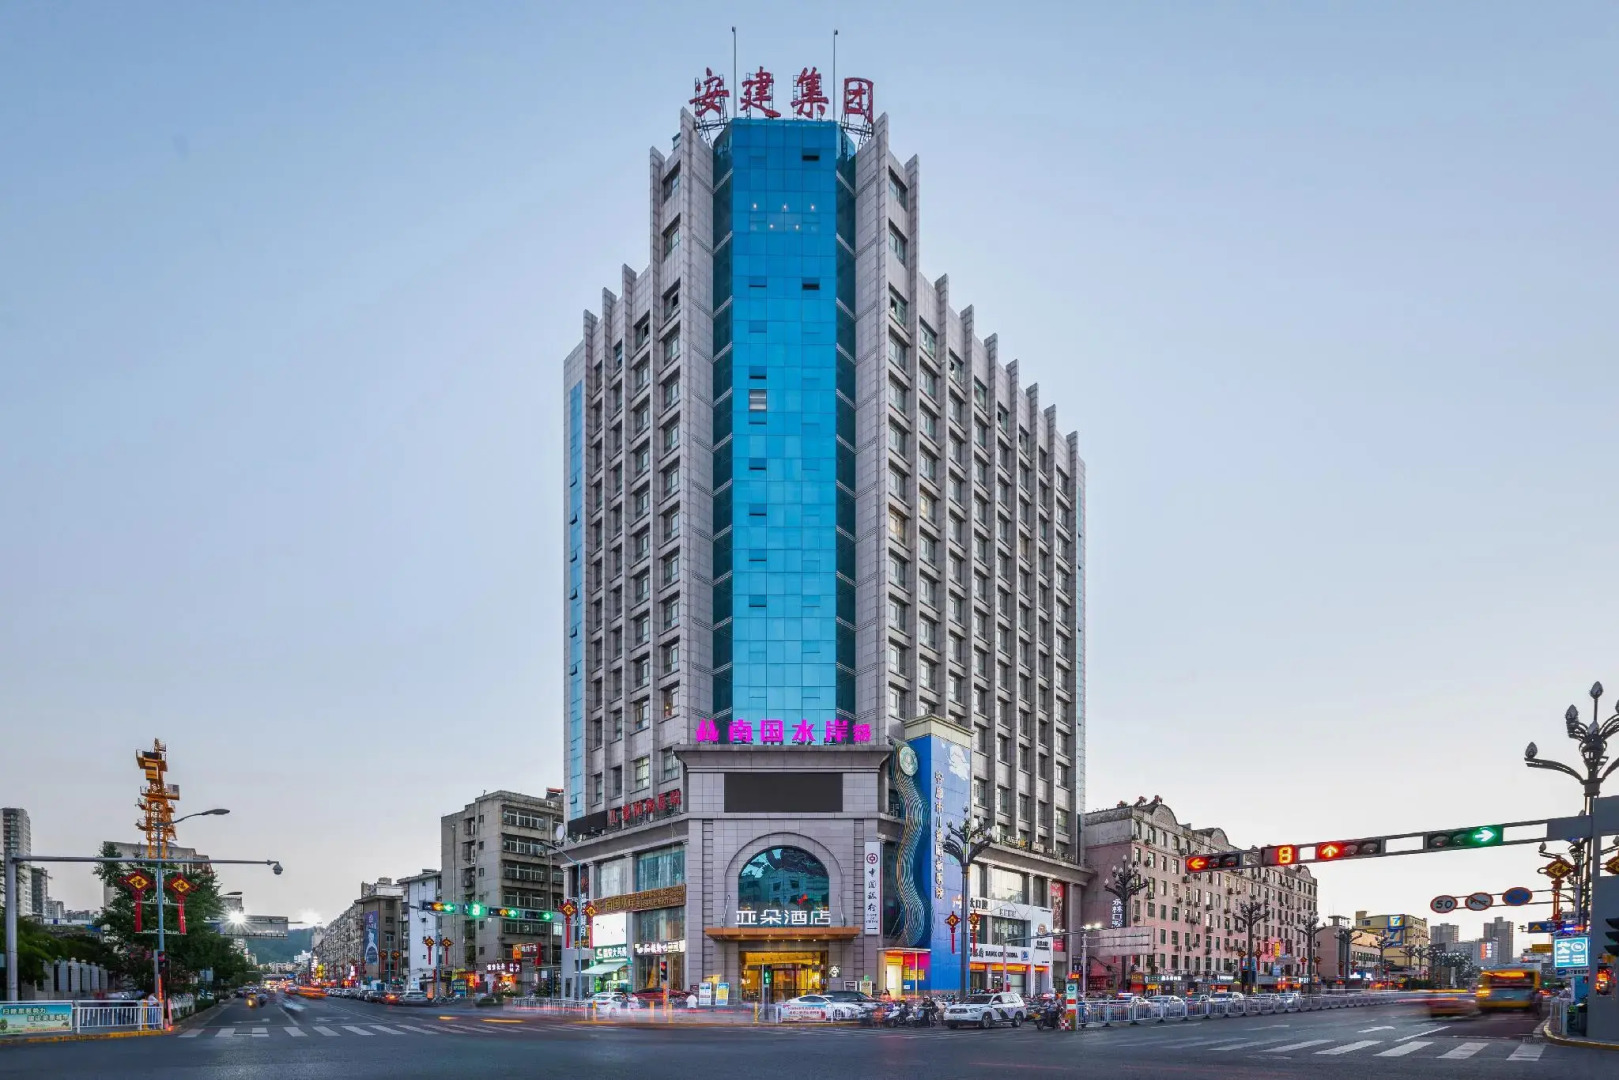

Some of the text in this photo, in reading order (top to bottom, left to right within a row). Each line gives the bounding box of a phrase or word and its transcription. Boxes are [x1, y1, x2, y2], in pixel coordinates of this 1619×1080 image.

[689, 66, 874, 124] 安建集团
[728, 719, 849, 742] 南国水岸
[1279, 846, 1292, 864] 8
[1435, 900, 1453, 909] 50
[734, 909, 832, 925] 亚朵酒店
